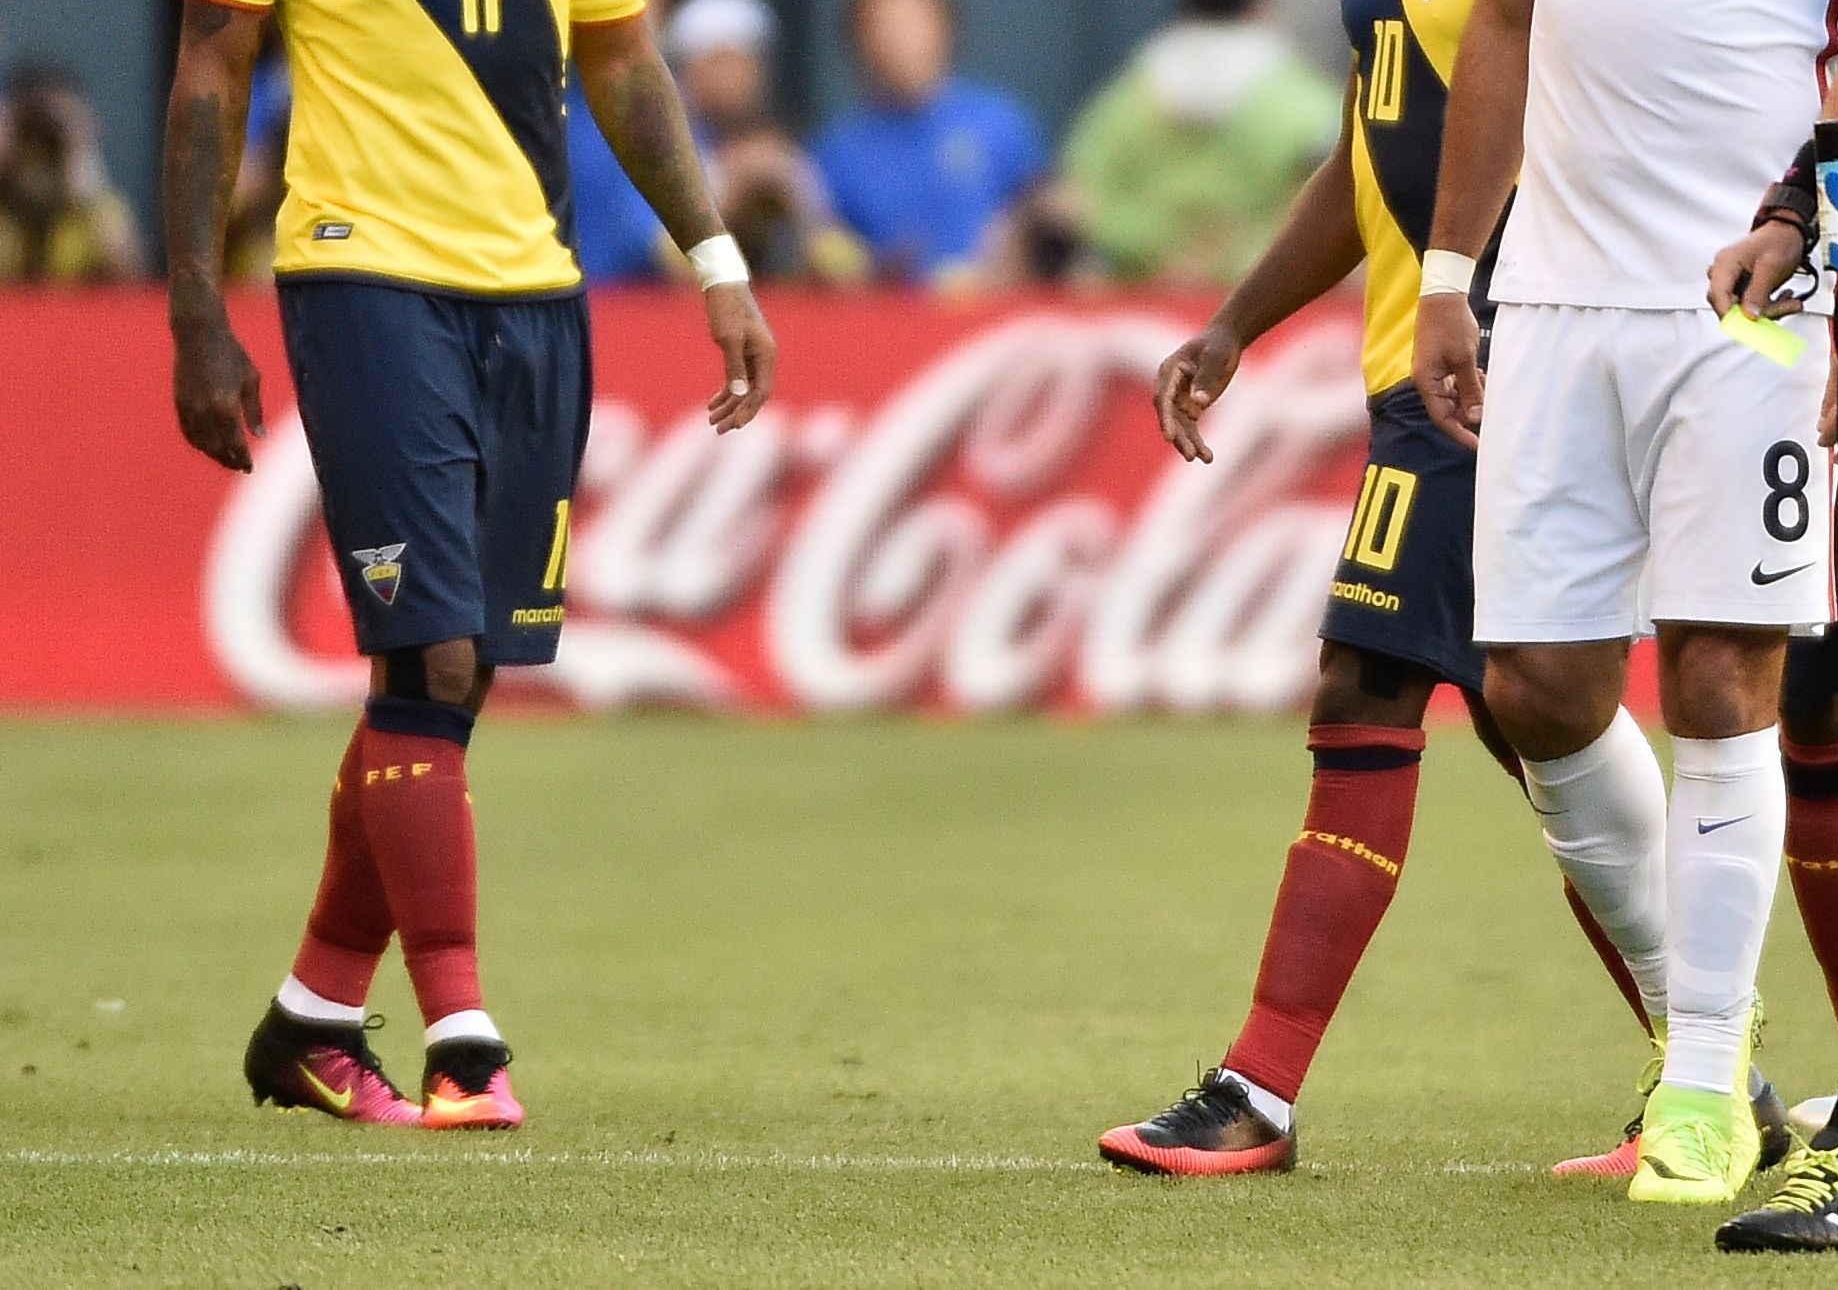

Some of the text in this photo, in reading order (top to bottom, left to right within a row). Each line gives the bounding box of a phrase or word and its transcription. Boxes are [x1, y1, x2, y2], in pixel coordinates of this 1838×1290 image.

[1367, 20, 1404, 121] 10
[1344, 464, 1417, 571] 10
[1762, 439, 1810, 543] 8
[543, 498, 571, 590] 1
